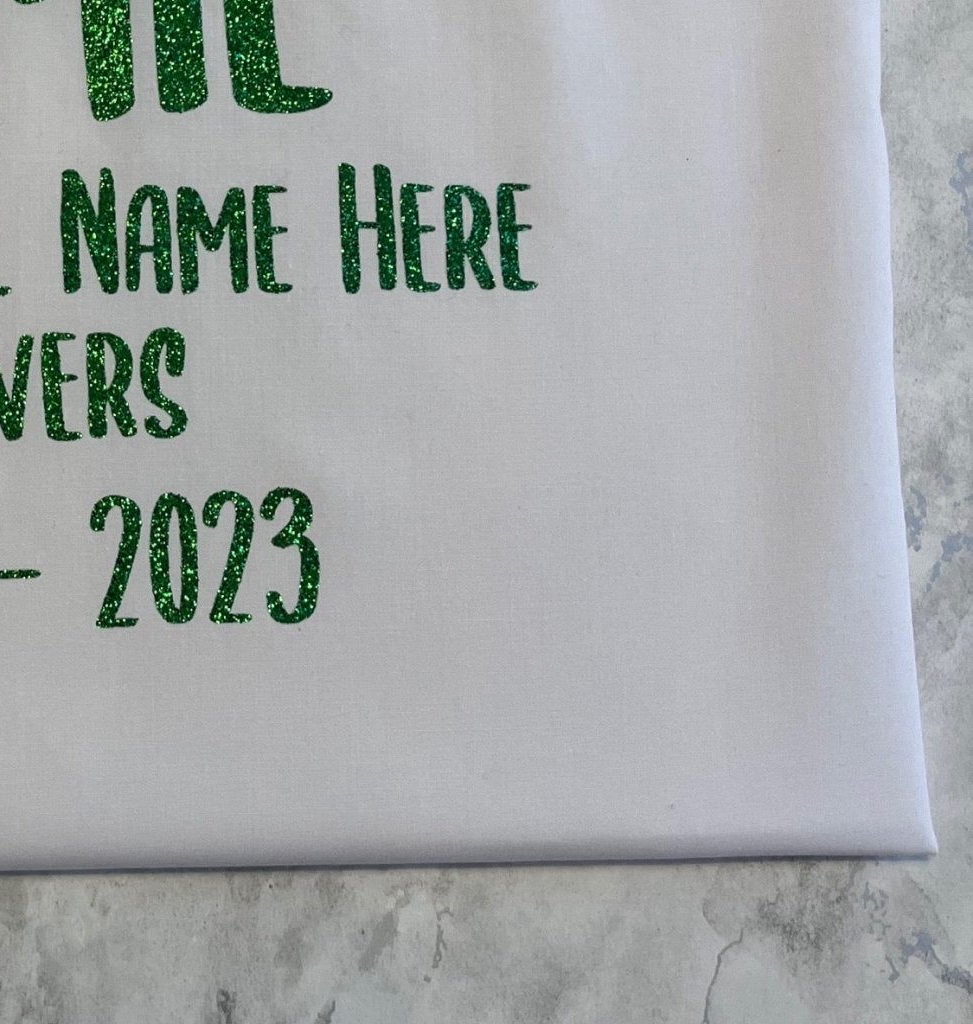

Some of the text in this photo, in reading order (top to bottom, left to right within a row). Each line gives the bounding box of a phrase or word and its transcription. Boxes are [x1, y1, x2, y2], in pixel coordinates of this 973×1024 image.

[60, 168, 292, 295] NAME
[338, 163, 538, 294] HERE
[90, 487, 320, 628] 2023
